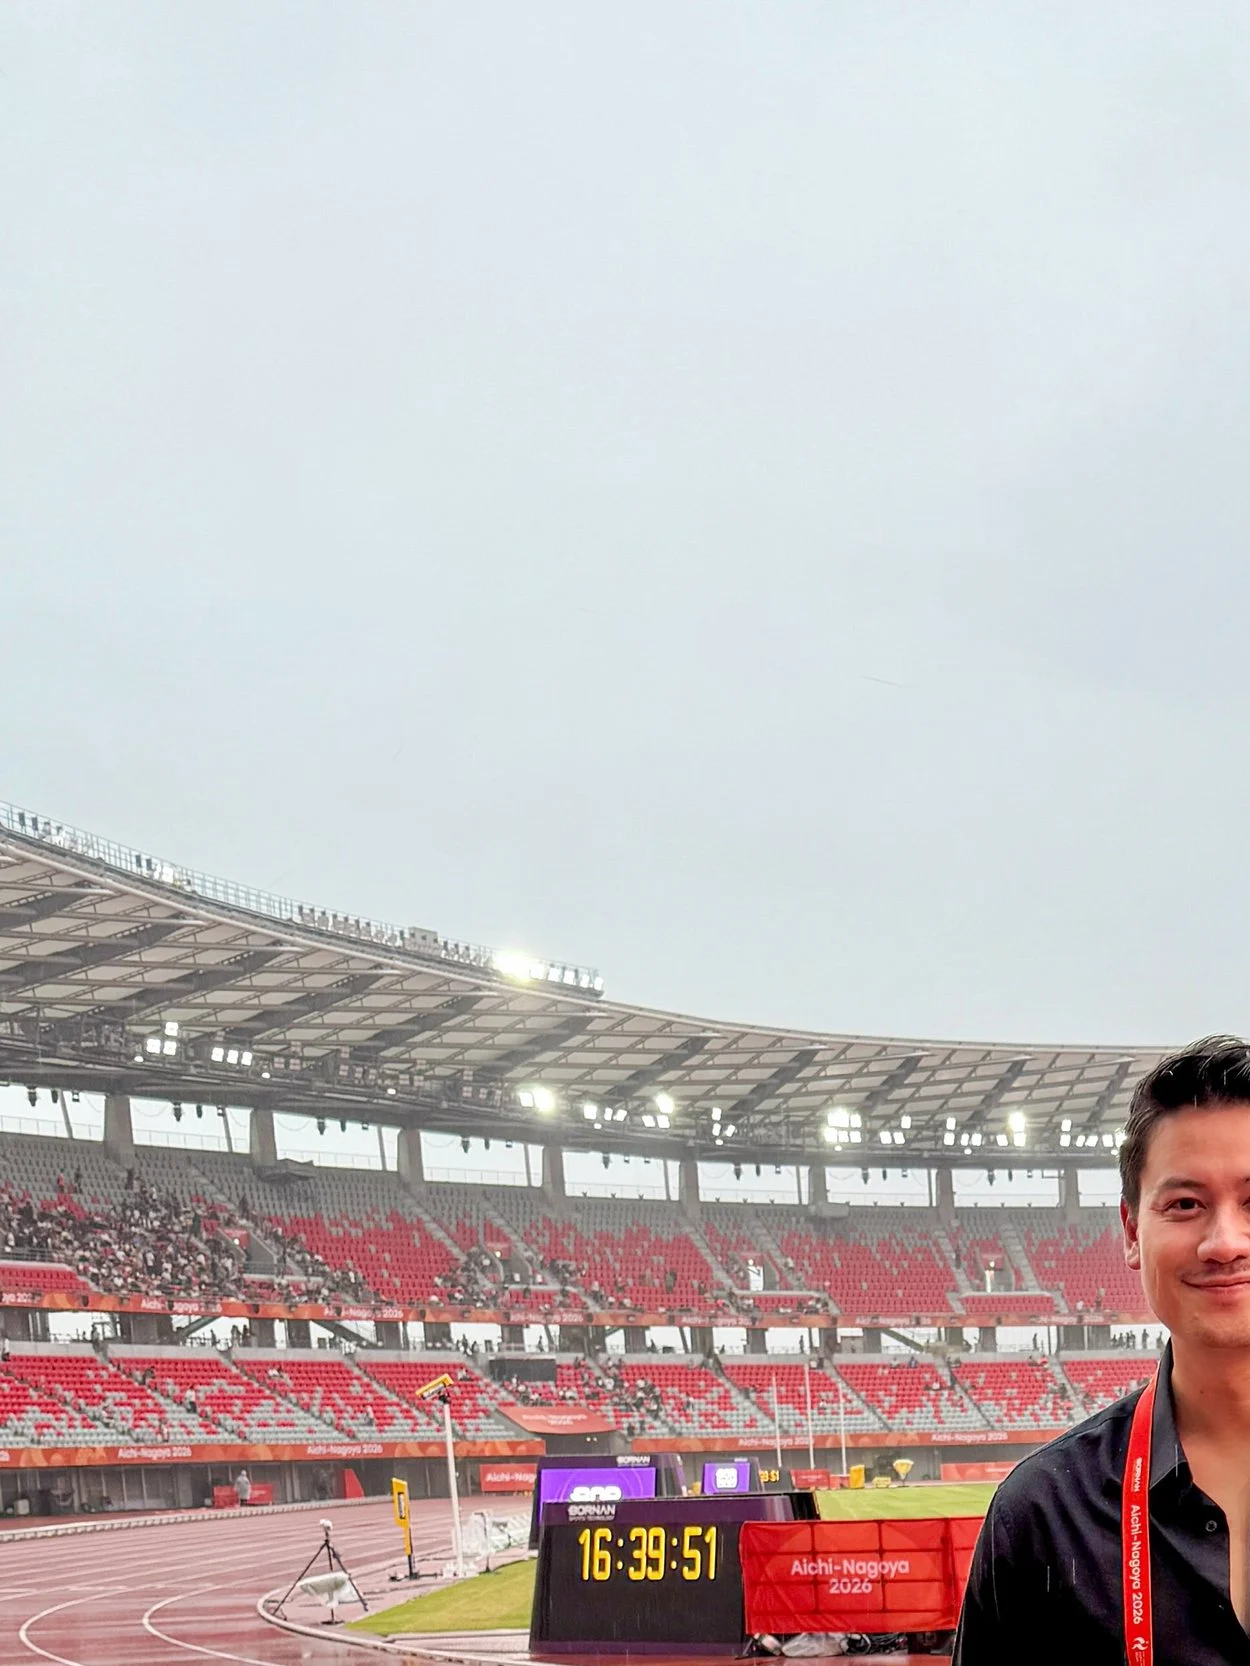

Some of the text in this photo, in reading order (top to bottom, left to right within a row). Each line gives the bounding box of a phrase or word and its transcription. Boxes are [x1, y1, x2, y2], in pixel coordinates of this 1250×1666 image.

[932, 1432, 1008, 1444] Aichi-Nagoya 2026
[118, 1446, 193, 1461] Aichi-Nagoya 2026
[306, 1443, 383, 1457] Aichi-Nagoya 2026
[578, 1526, 717, 1581] 16:39:51
[1129, 1504, 1142, 1590] Aichi-Nagoya
[791, 1558, 910, 1579] Aichi-Nagoya
[829, 1578, 873, 1594] 2026
[1132, 1593, 1143, 1625] 2026
